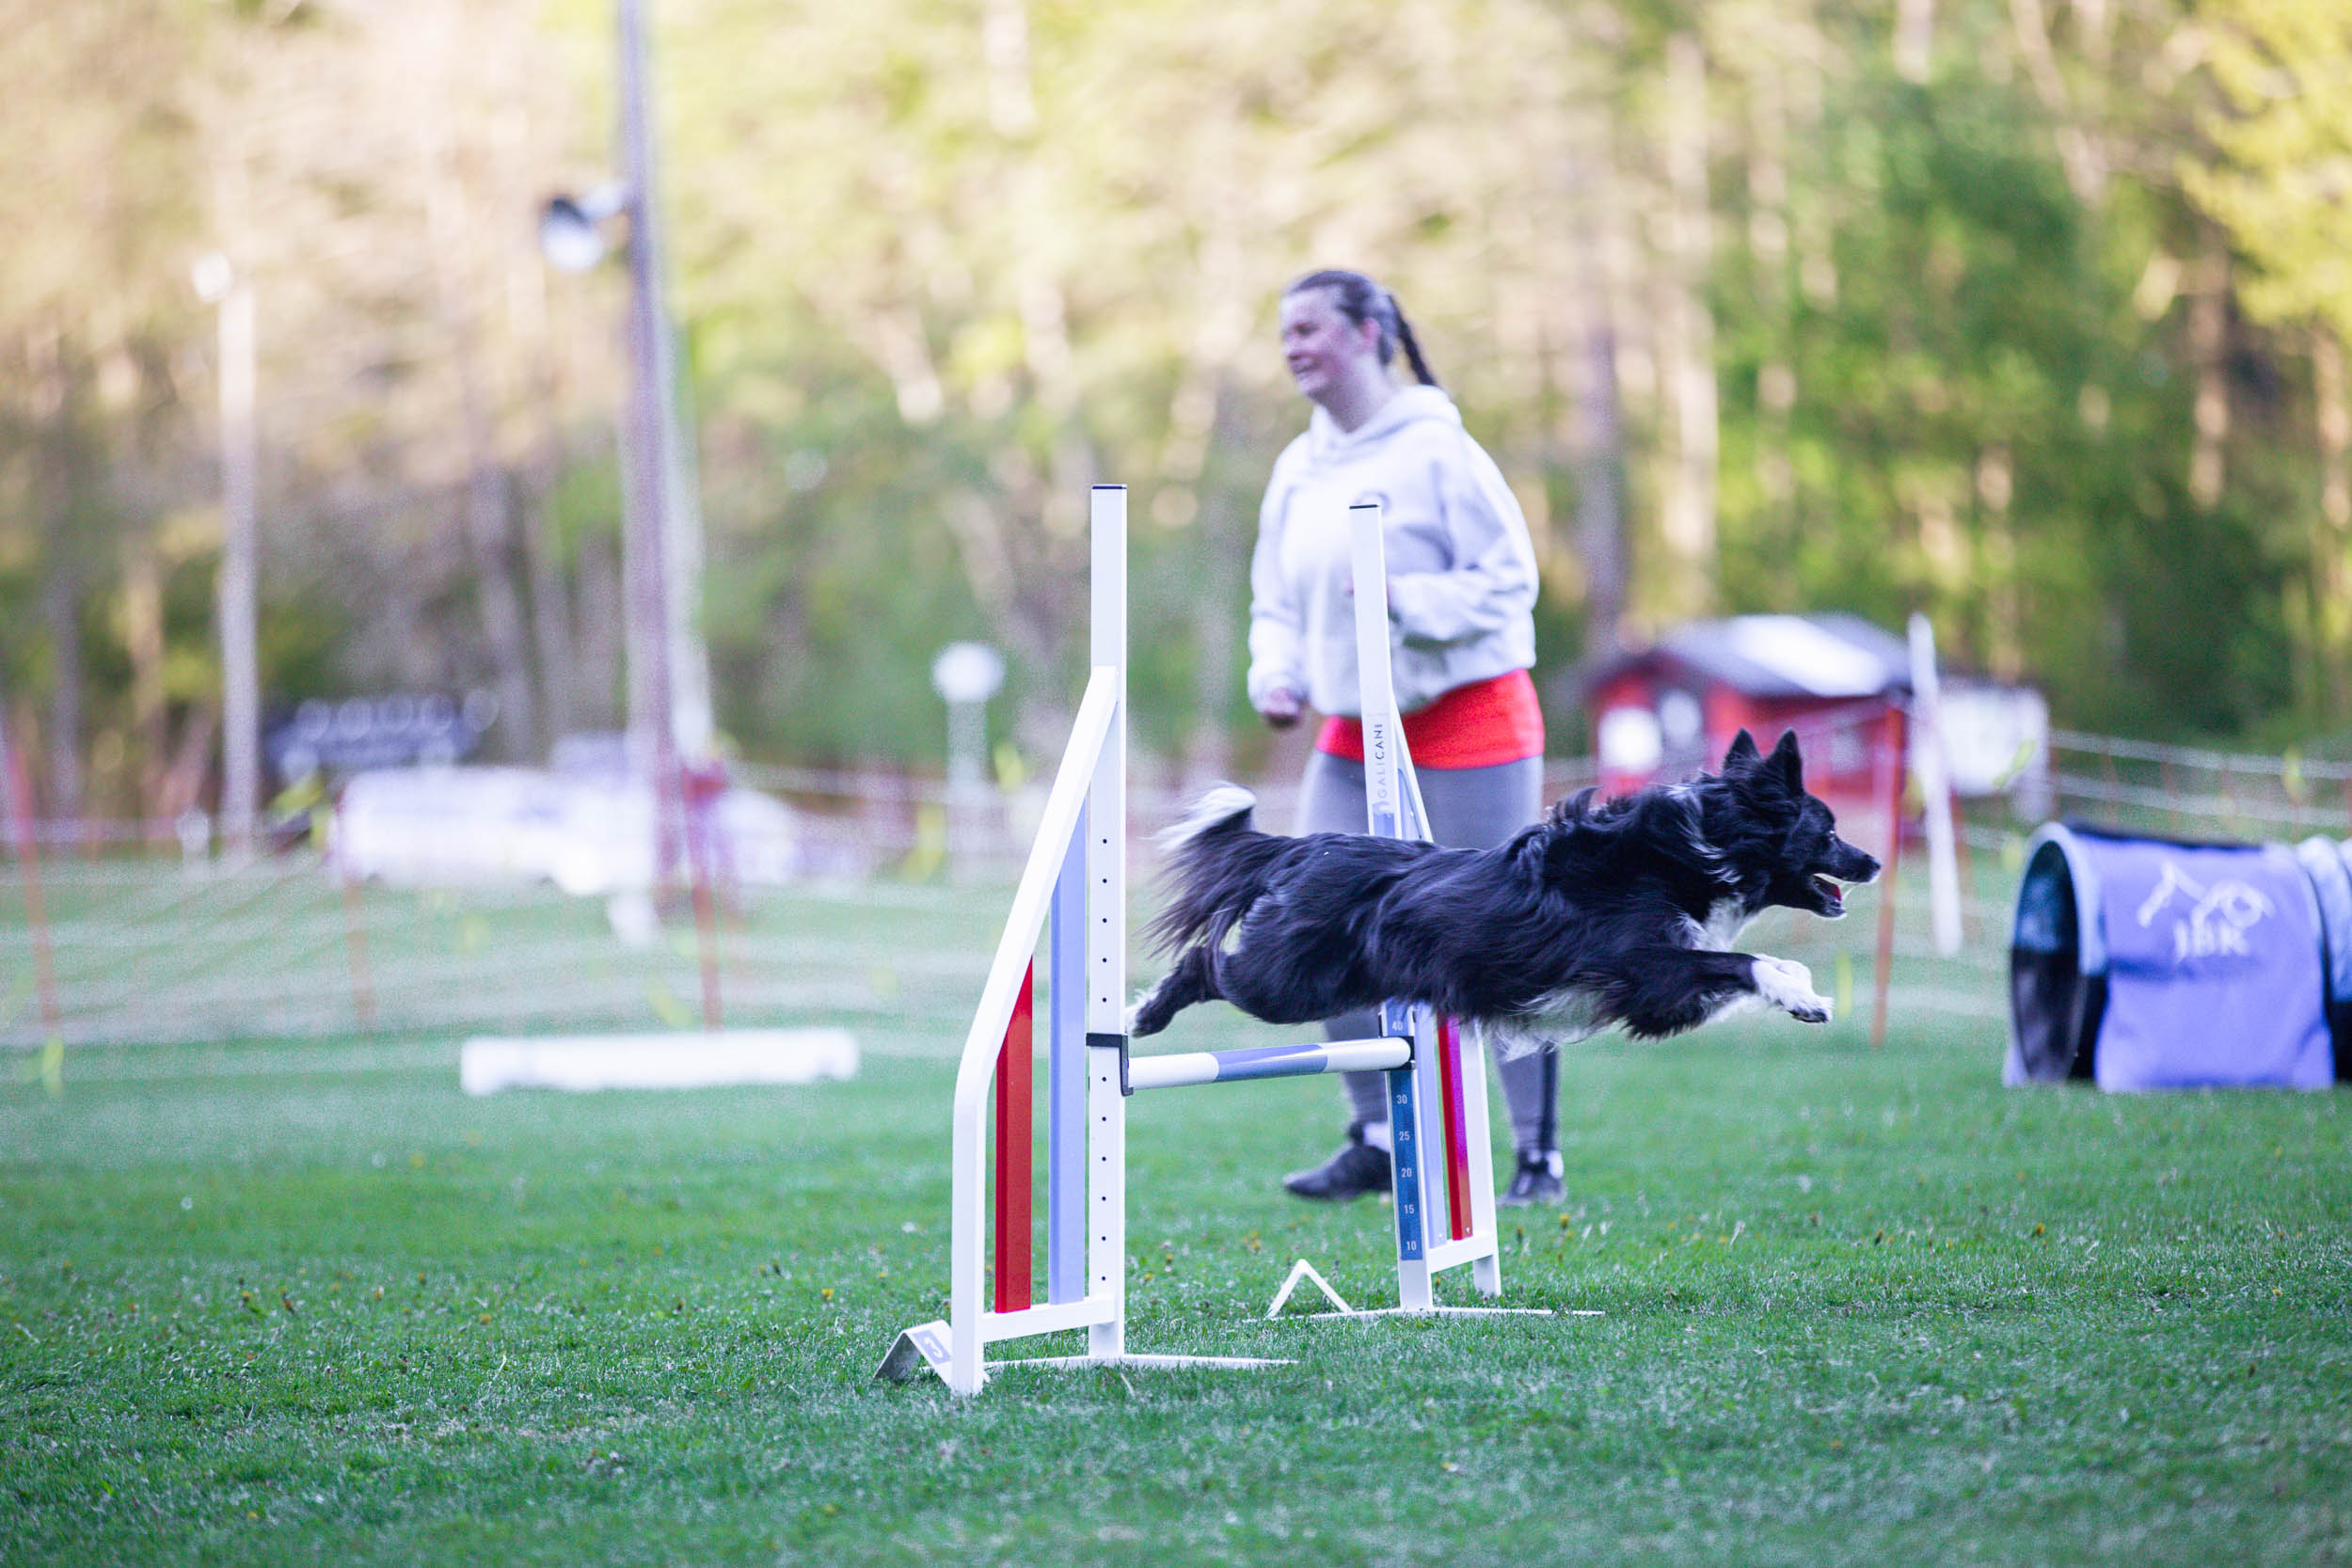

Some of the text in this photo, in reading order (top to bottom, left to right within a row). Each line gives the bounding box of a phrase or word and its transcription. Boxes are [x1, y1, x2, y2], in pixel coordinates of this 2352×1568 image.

[1391, 1021, 1404, 1032] 40
[1396, 1095, 1408, 1105] 30
[1398, 1131, 1410, 1141] 25
[1401, 1167, 1412, 1178] 20
[1404, 1204, 1415, 1214] 15
[1406, 1241, 1417, 1251] 10
[924, 1338, 943, 1357] 3
